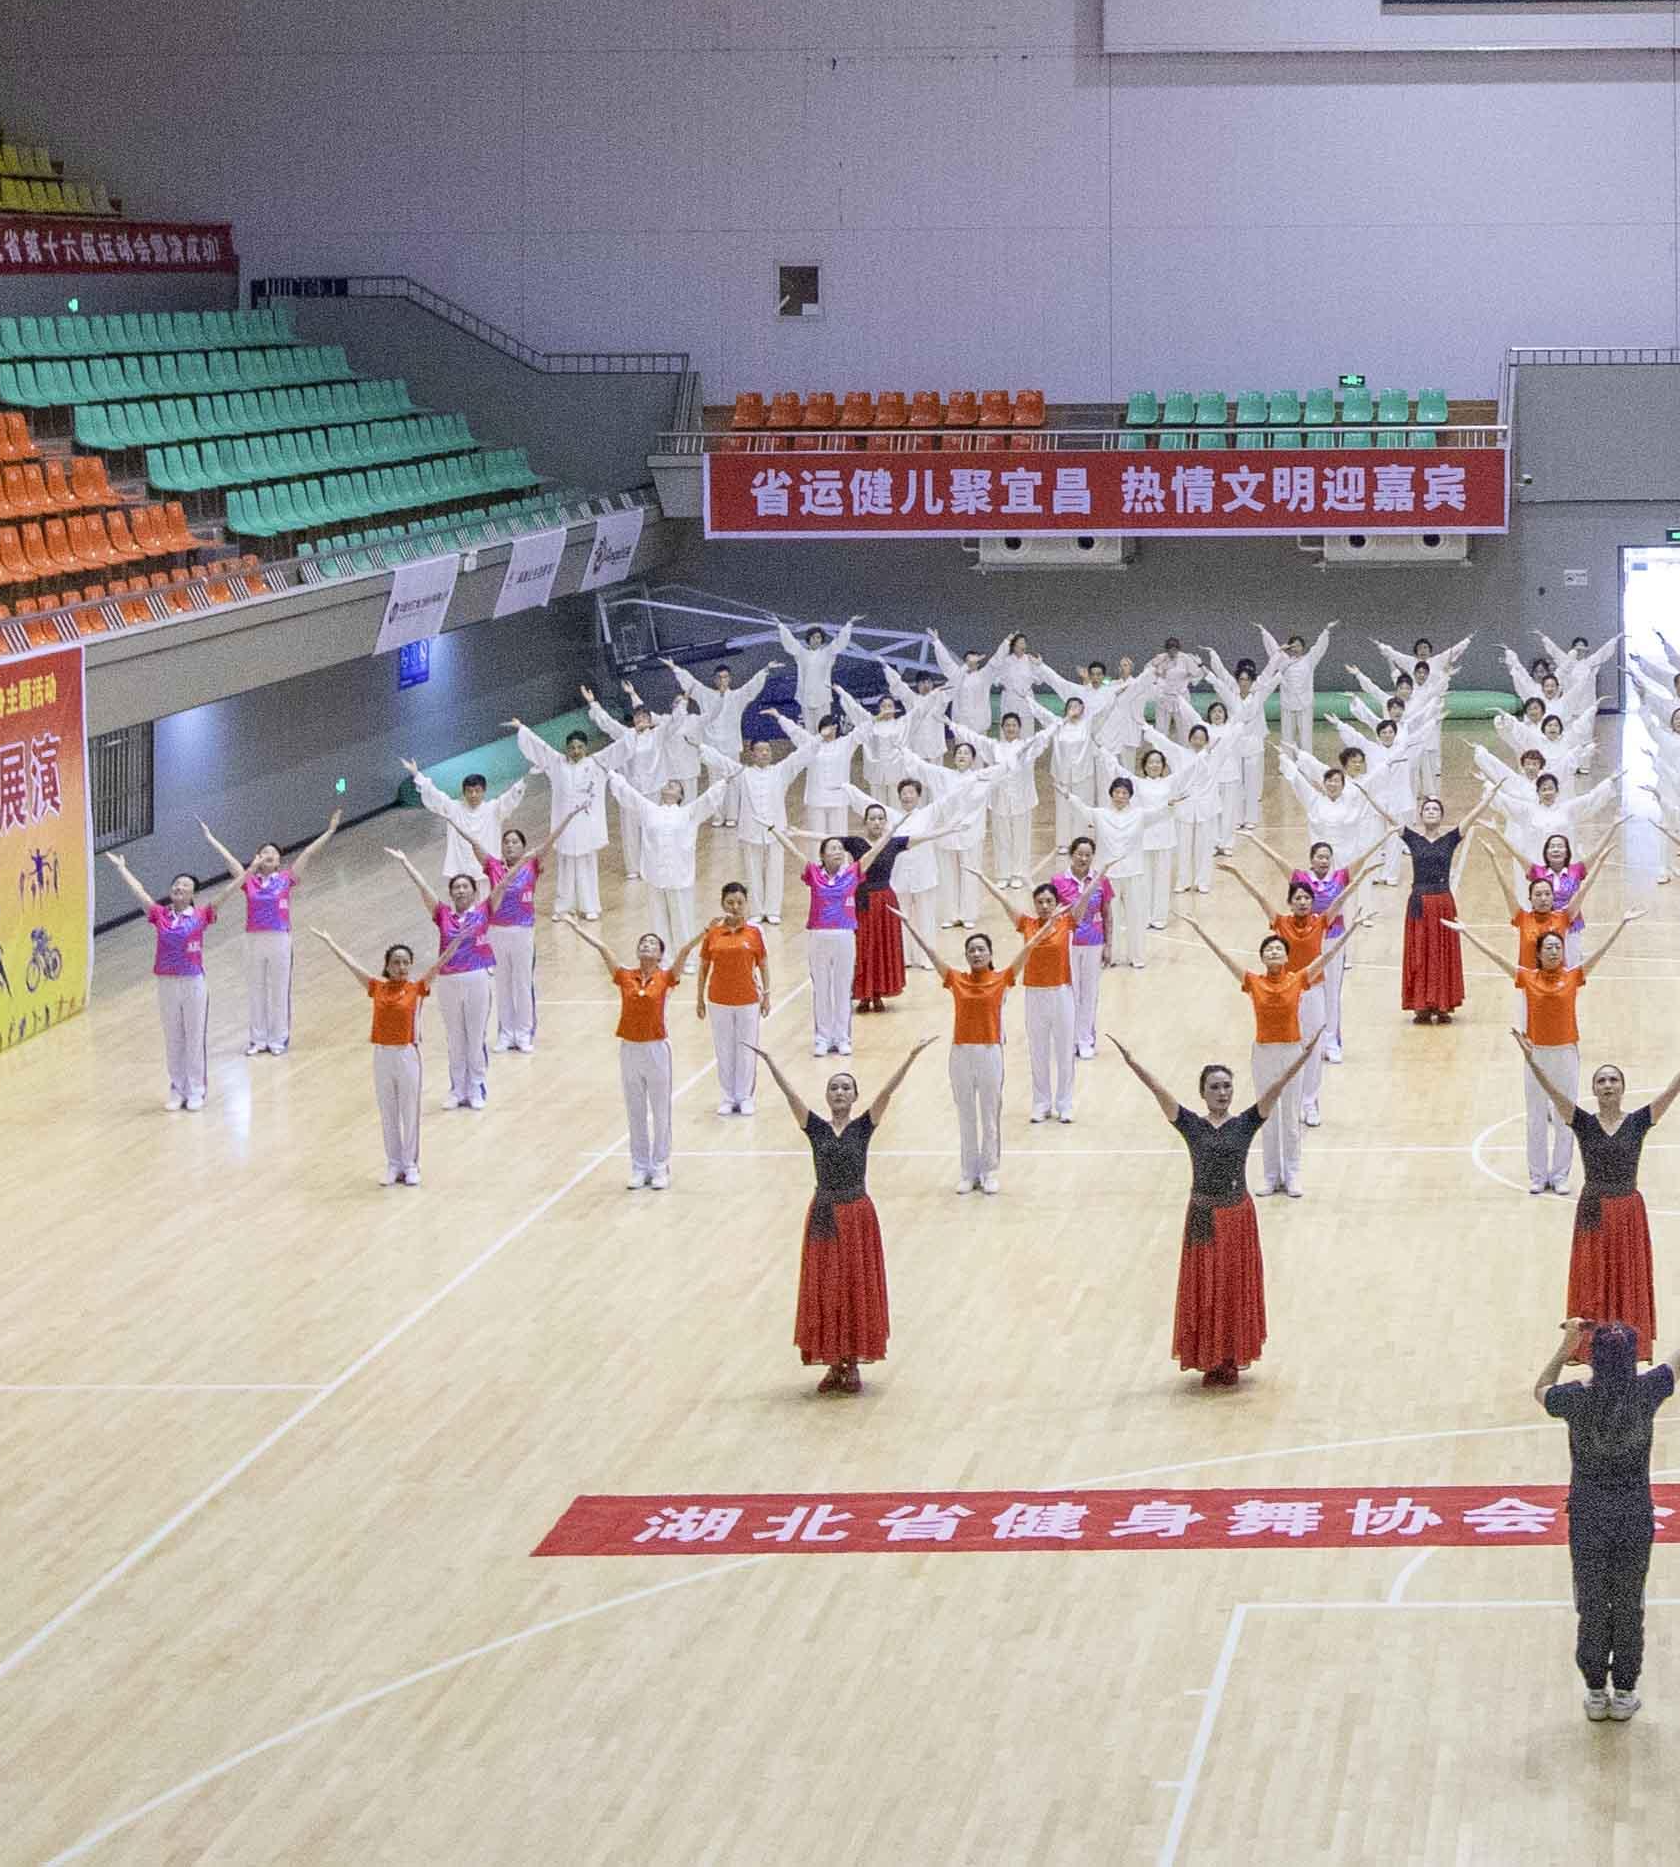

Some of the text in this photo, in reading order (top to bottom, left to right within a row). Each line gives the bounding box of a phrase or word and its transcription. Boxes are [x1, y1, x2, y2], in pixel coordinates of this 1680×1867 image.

[750, 466, 1468, 517] 省运健儿聚宜昌 热情文明迎嘉宾
